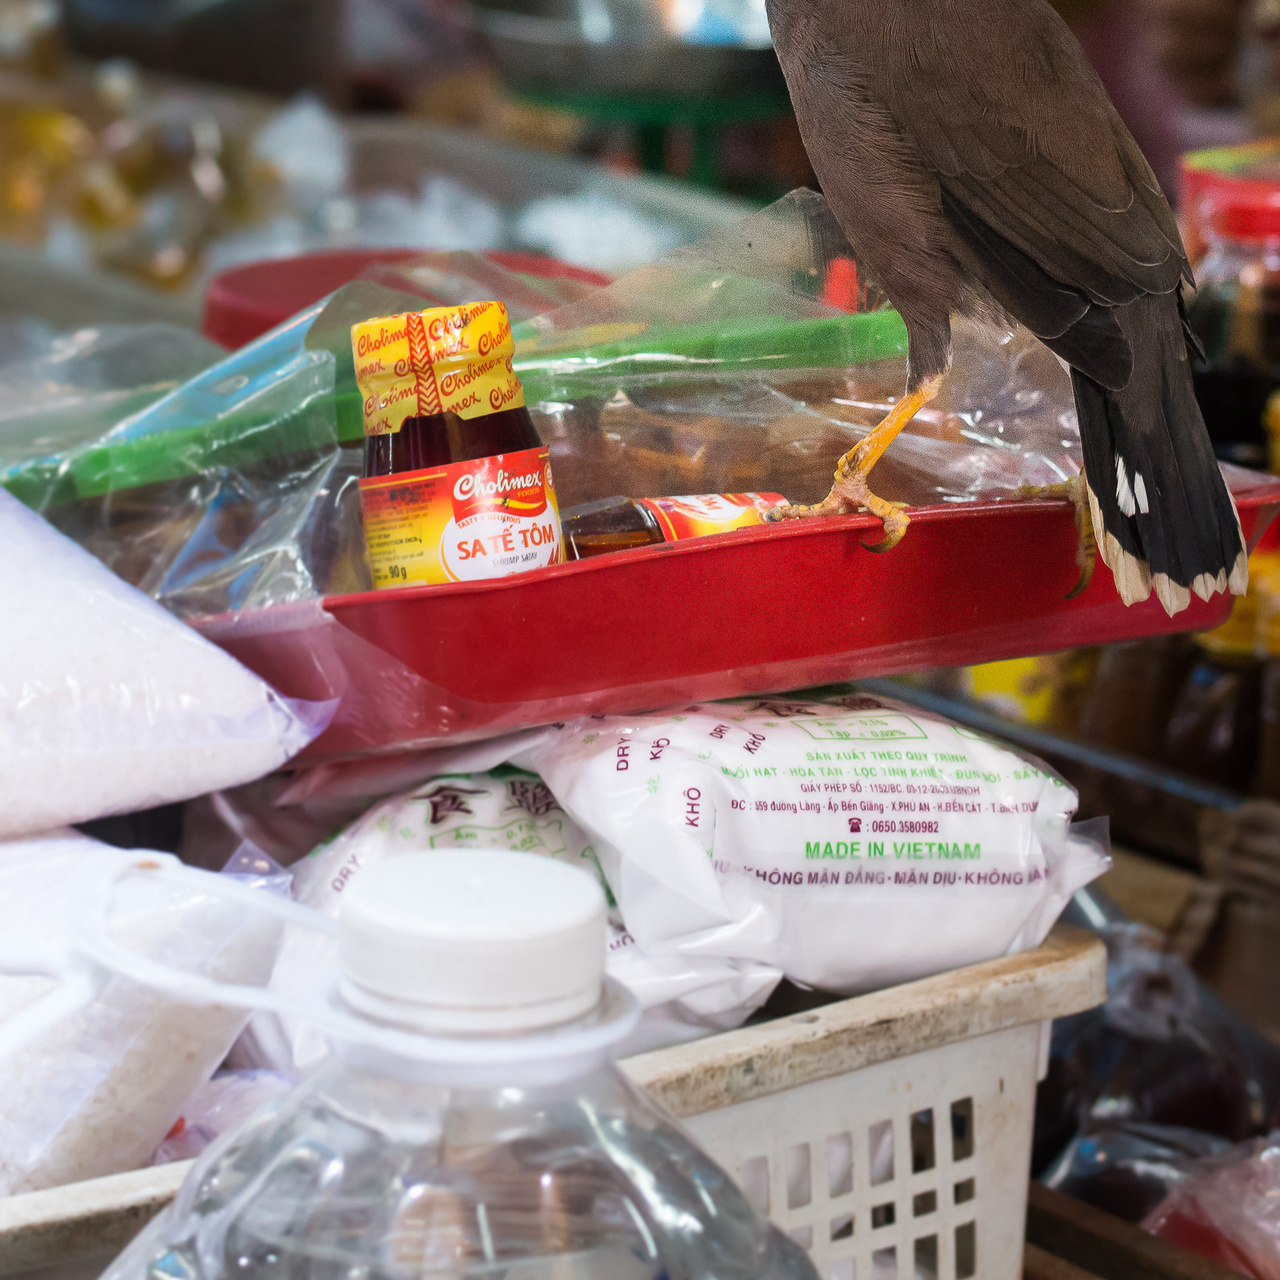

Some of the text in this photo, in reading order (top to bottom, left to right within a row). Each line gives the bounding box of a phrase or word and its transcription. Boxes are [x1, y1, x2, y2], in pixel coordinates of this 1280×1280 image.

[453, 469, 543, 501] Cholimex
[457, 517, 478, 529] TASTY
[456, 538, 488, 561] SA
[487, 524, 515, 555] TẾ
[518, 522, 556, 549] TÔM
[492, 551, 538, 567] SHRIMP SATAY
[710, 724, 731, 740] DRY
[616, 737, 632, 771] DRY
[870, 751, 902, 761] THEO
[905, 751, 928, 762] QUY
[818, 767, 843, 777] TAN
[853, 767, 877, 779] LỌC
[882, 767, 907, 778] TINH
[682, 787, 702, 828] KHÔ
[731, 799, 746, 811] ĐC
[799, 800, 821, 814] Làng
[919, 802, 930, 812] AN
[872, 820, 939, 833] 0650.3580982
[805, 841, 981, 861] MADE IN VIETNAM
[331, 853, 361, 893] DRY
[932, 871, 957, 887] DỊU
[964, 868, 1024, 886] KHÔNG
